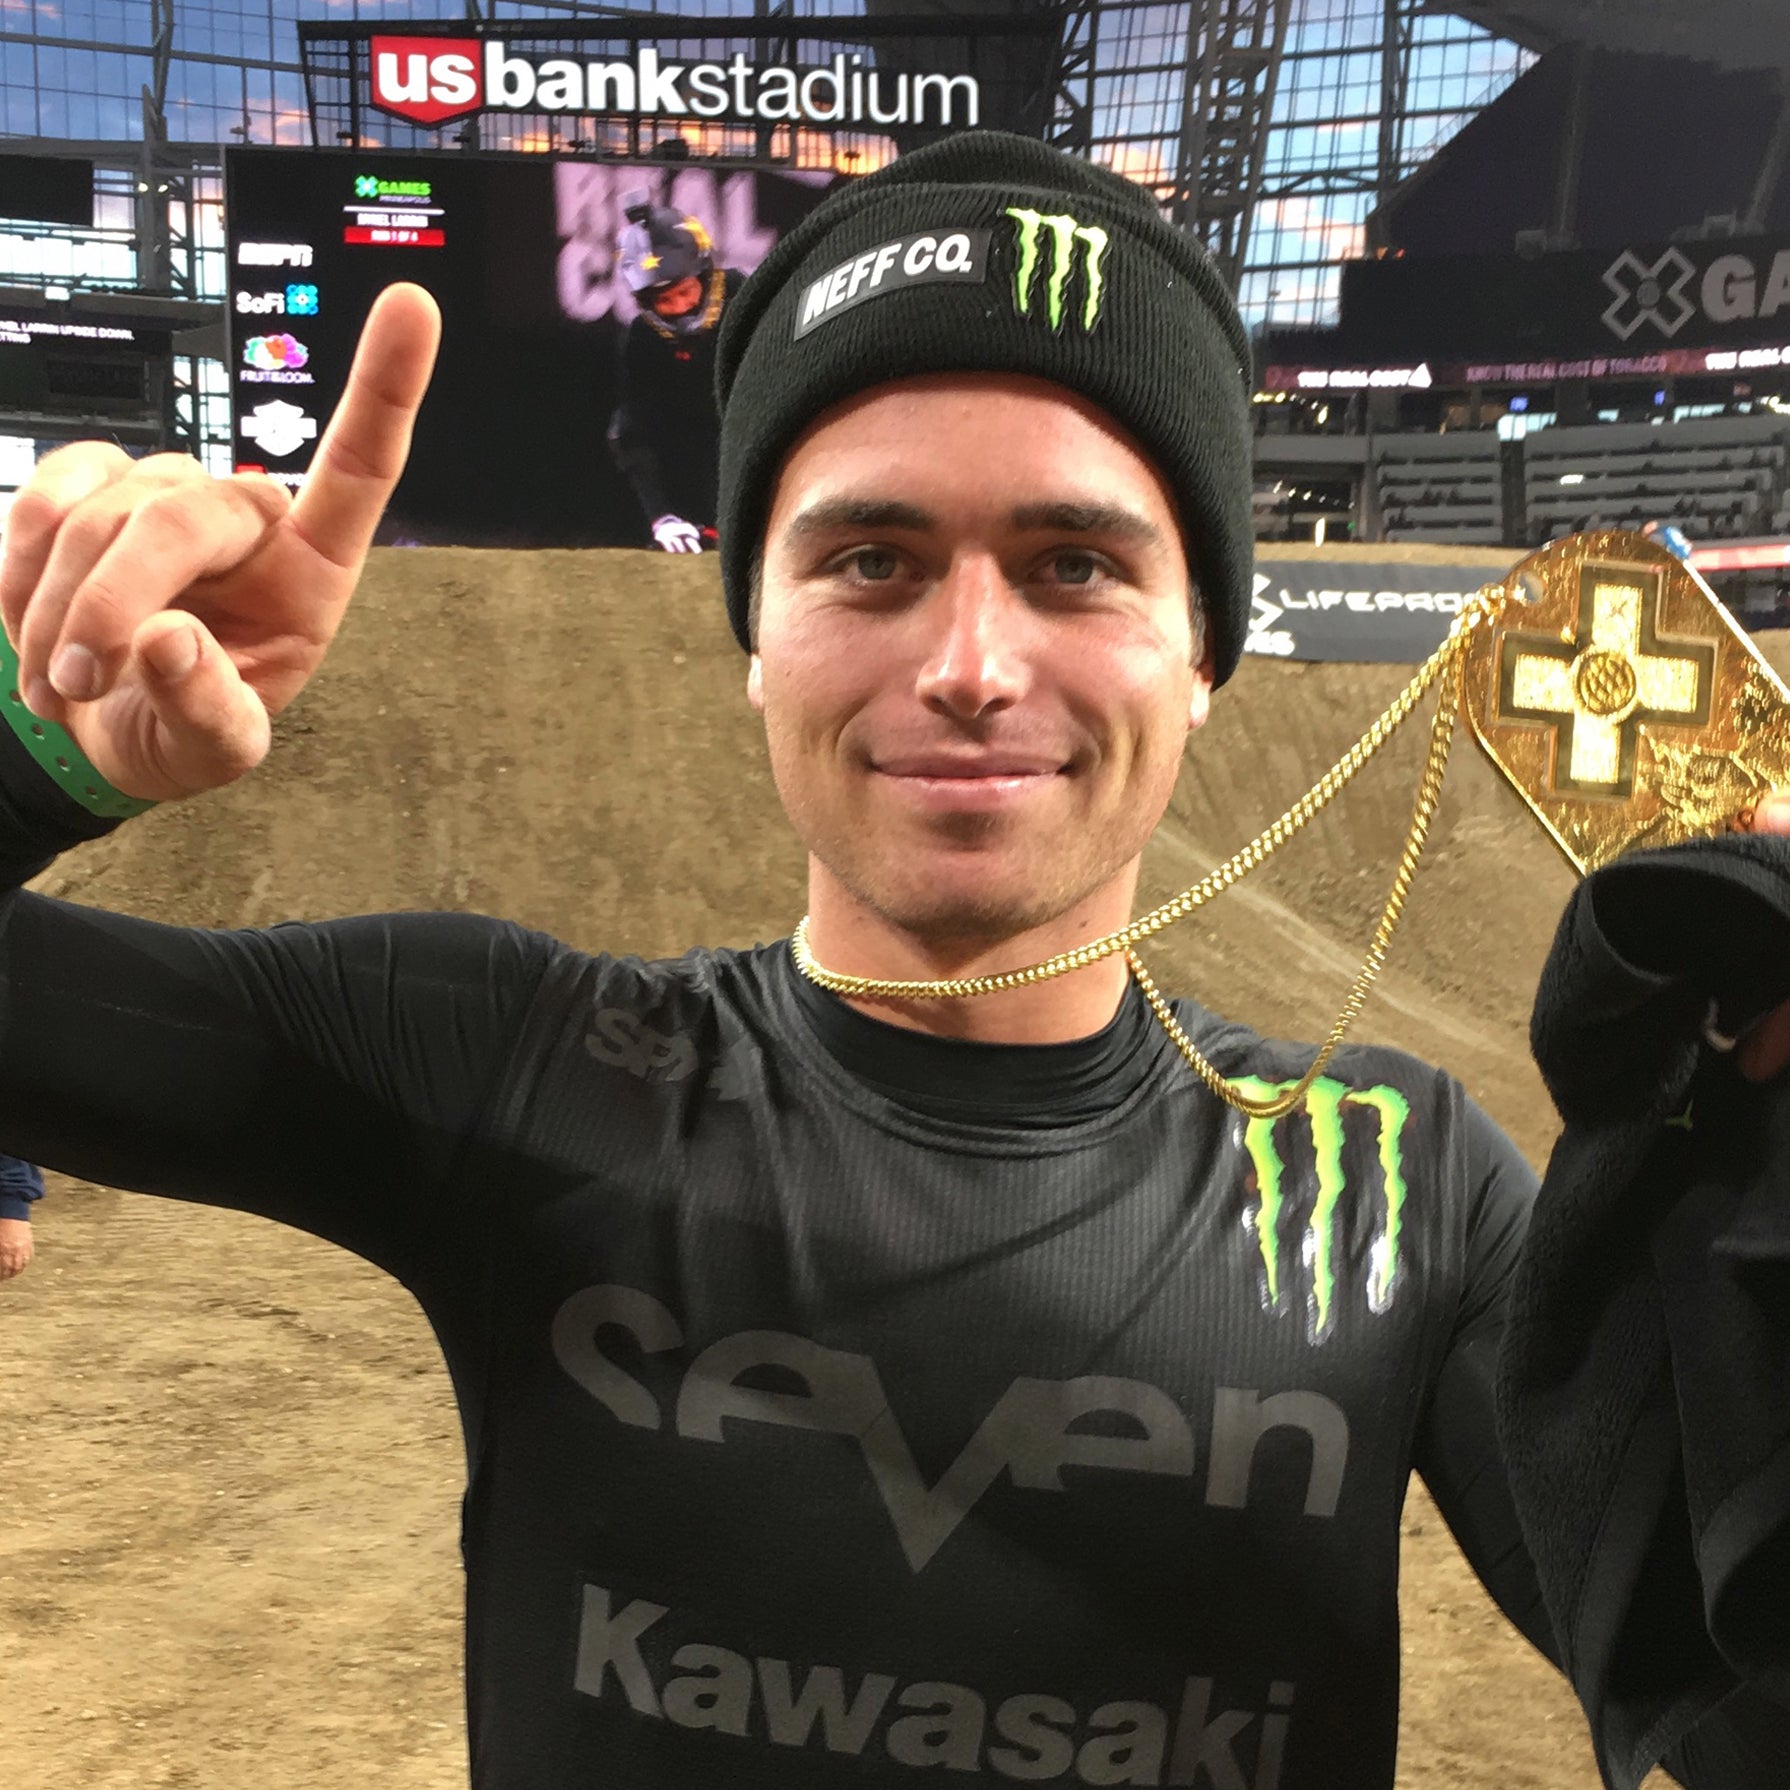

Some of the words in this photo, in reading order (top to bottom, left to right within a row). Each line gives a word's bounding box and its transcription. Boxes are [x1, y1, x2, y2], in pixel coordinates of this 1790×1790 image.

[801, 243, 902, 326] NEFF
[903, 233, 973, 276] CO.
[573, 1583, 1297, 1789] Kawasaki
